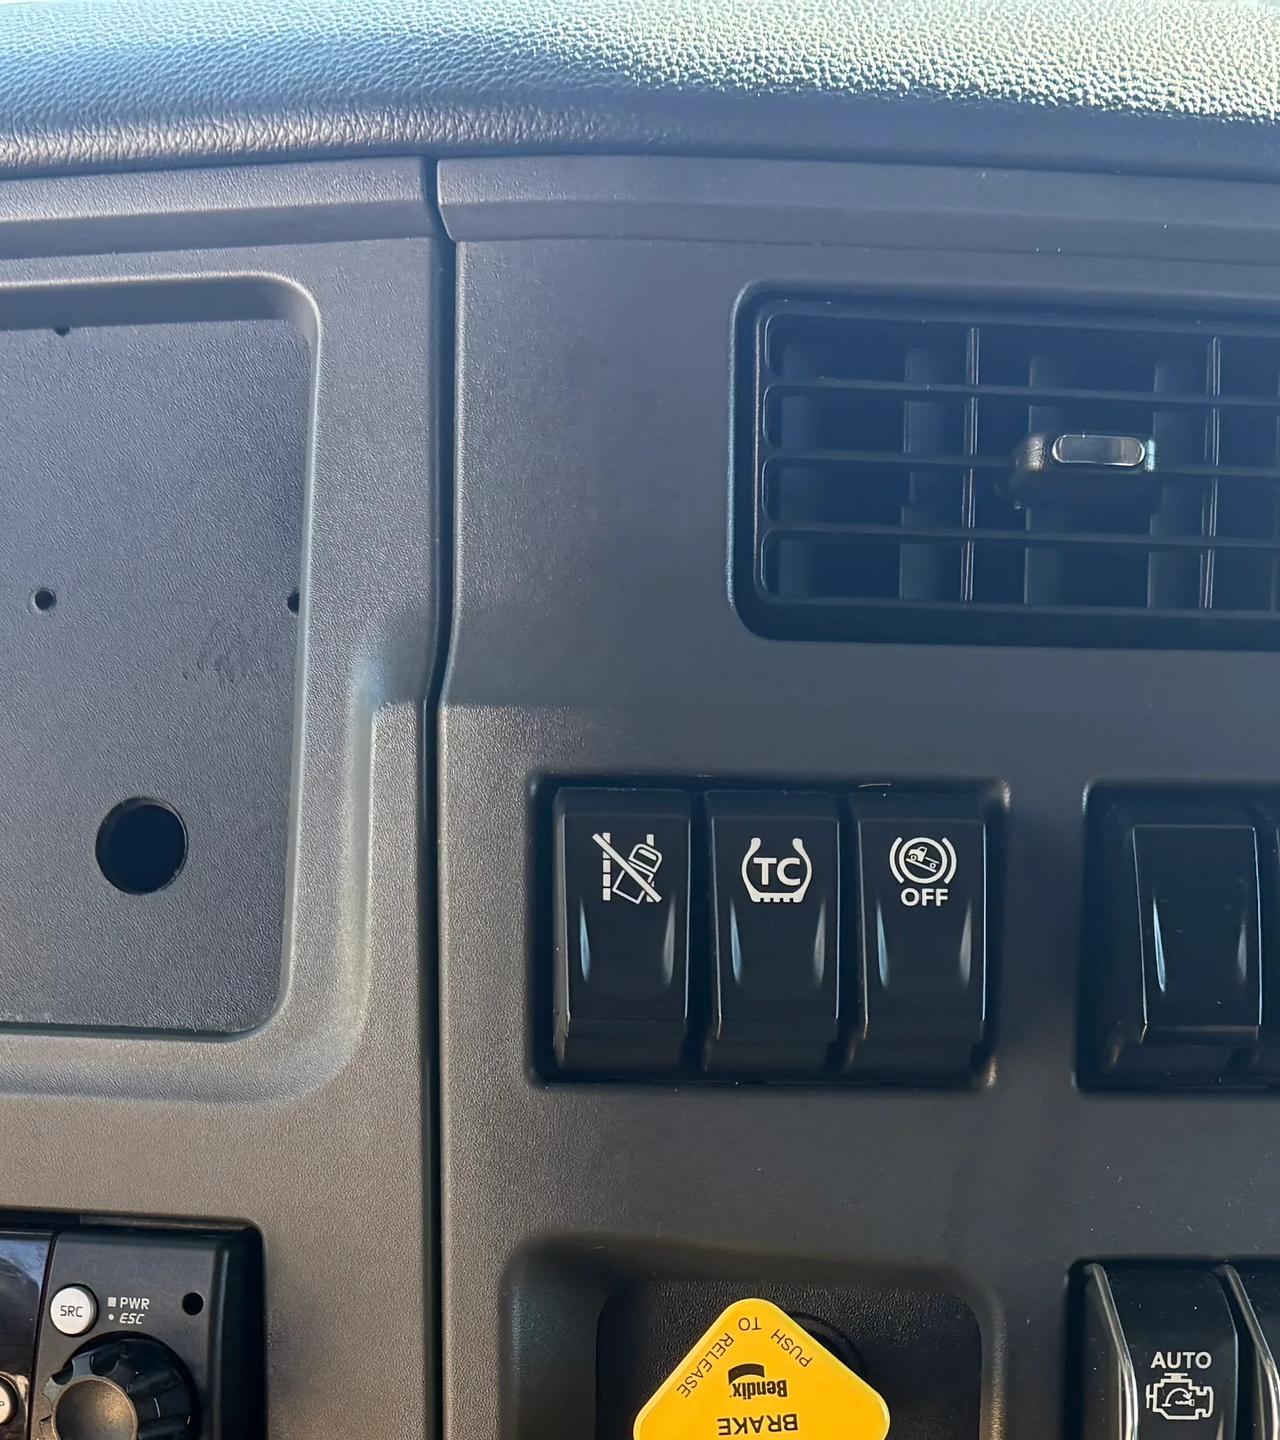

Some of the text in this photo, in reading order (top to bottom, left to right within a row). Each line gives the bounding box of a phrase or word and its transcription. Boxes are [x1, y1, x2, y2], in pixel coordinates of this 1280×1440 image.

[753, 857, 802, 886] TC
[900, 887, 949, 907] OFF
[60, 1305, 84, 1317] SRC
[120, 1297, 150, 1310] PWR
[120, 1312, 145, 1325] ESC
[676, 1317, 813, 1398] PUSH TO RELEASE
[1151, 1351, 1212, 1369] AUTO
[732, 1379, 788, 1400] Bendix
[717, 1413, 798, 1436] BRAKE
